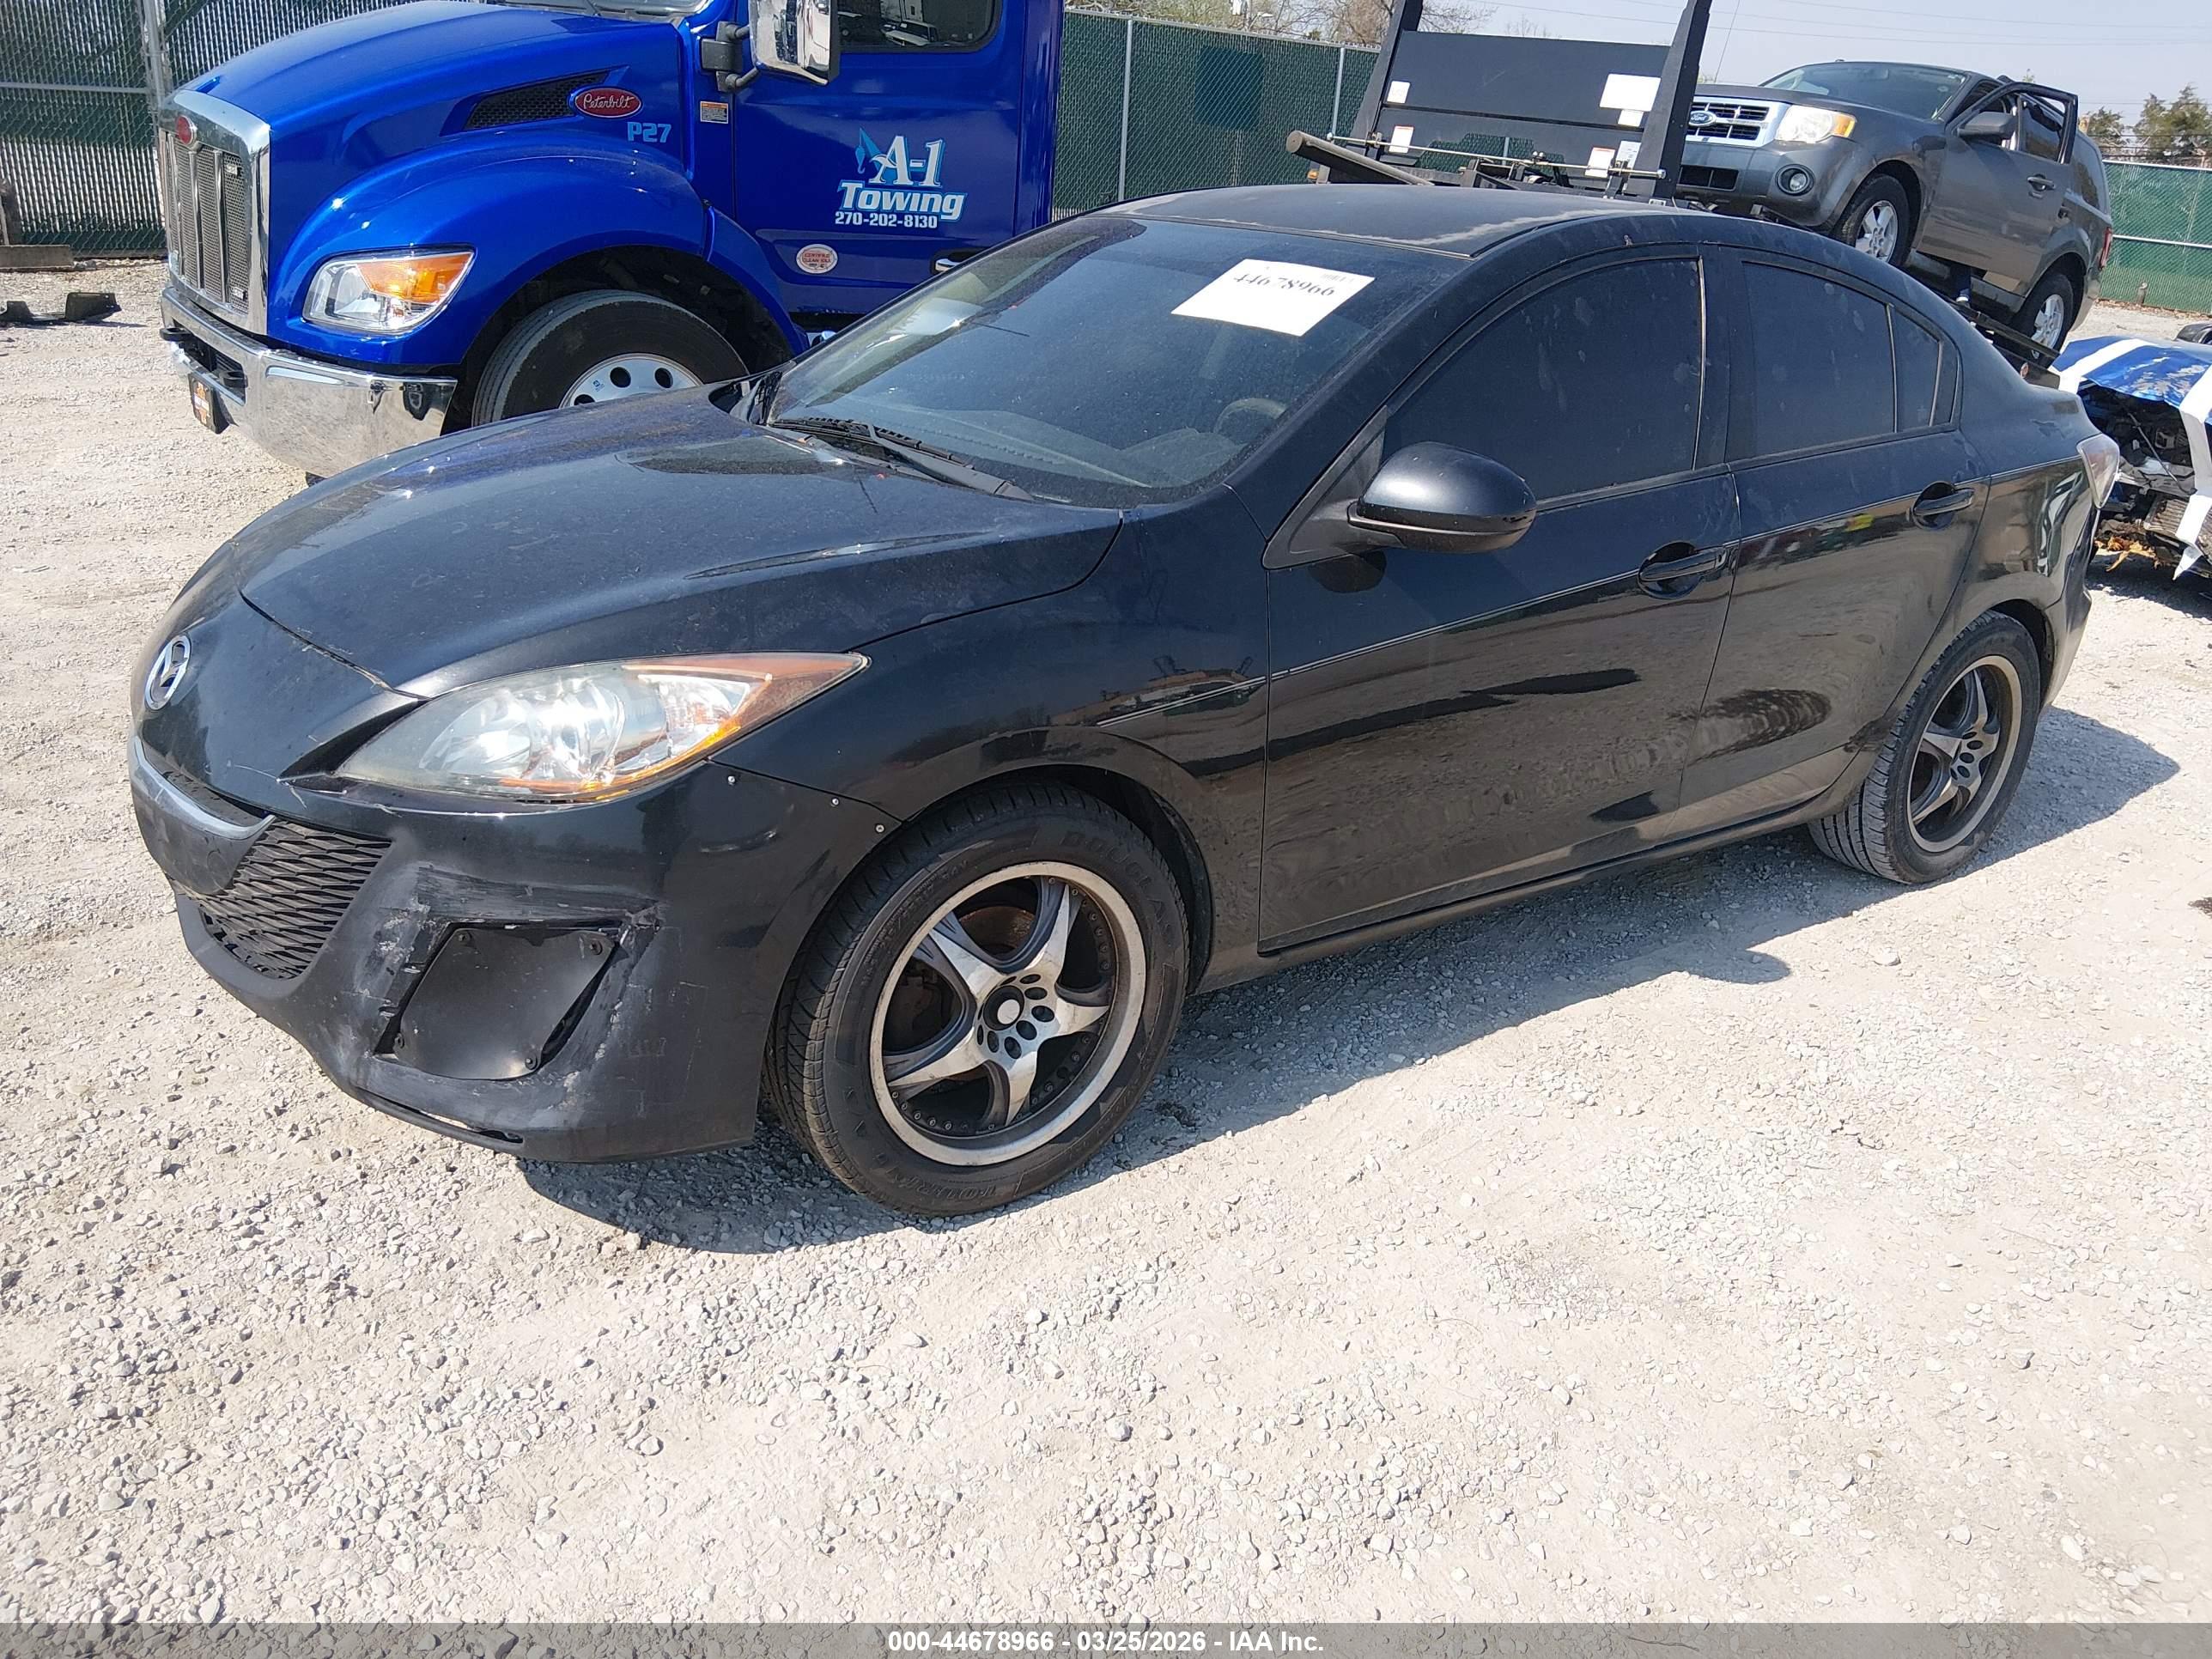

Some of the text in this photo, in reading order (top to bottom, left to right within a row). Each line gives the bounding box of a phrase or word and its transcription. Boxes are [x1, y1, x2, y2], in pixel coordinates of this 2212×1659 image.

[584, 93, 635, 109] Peterbilt
[627, 121, 672, 143] P27
[867, 135, 944, 188] A-1
[840, 181, 966, 222] Towing
[835, 211, 938, 228] 270-202-8130
